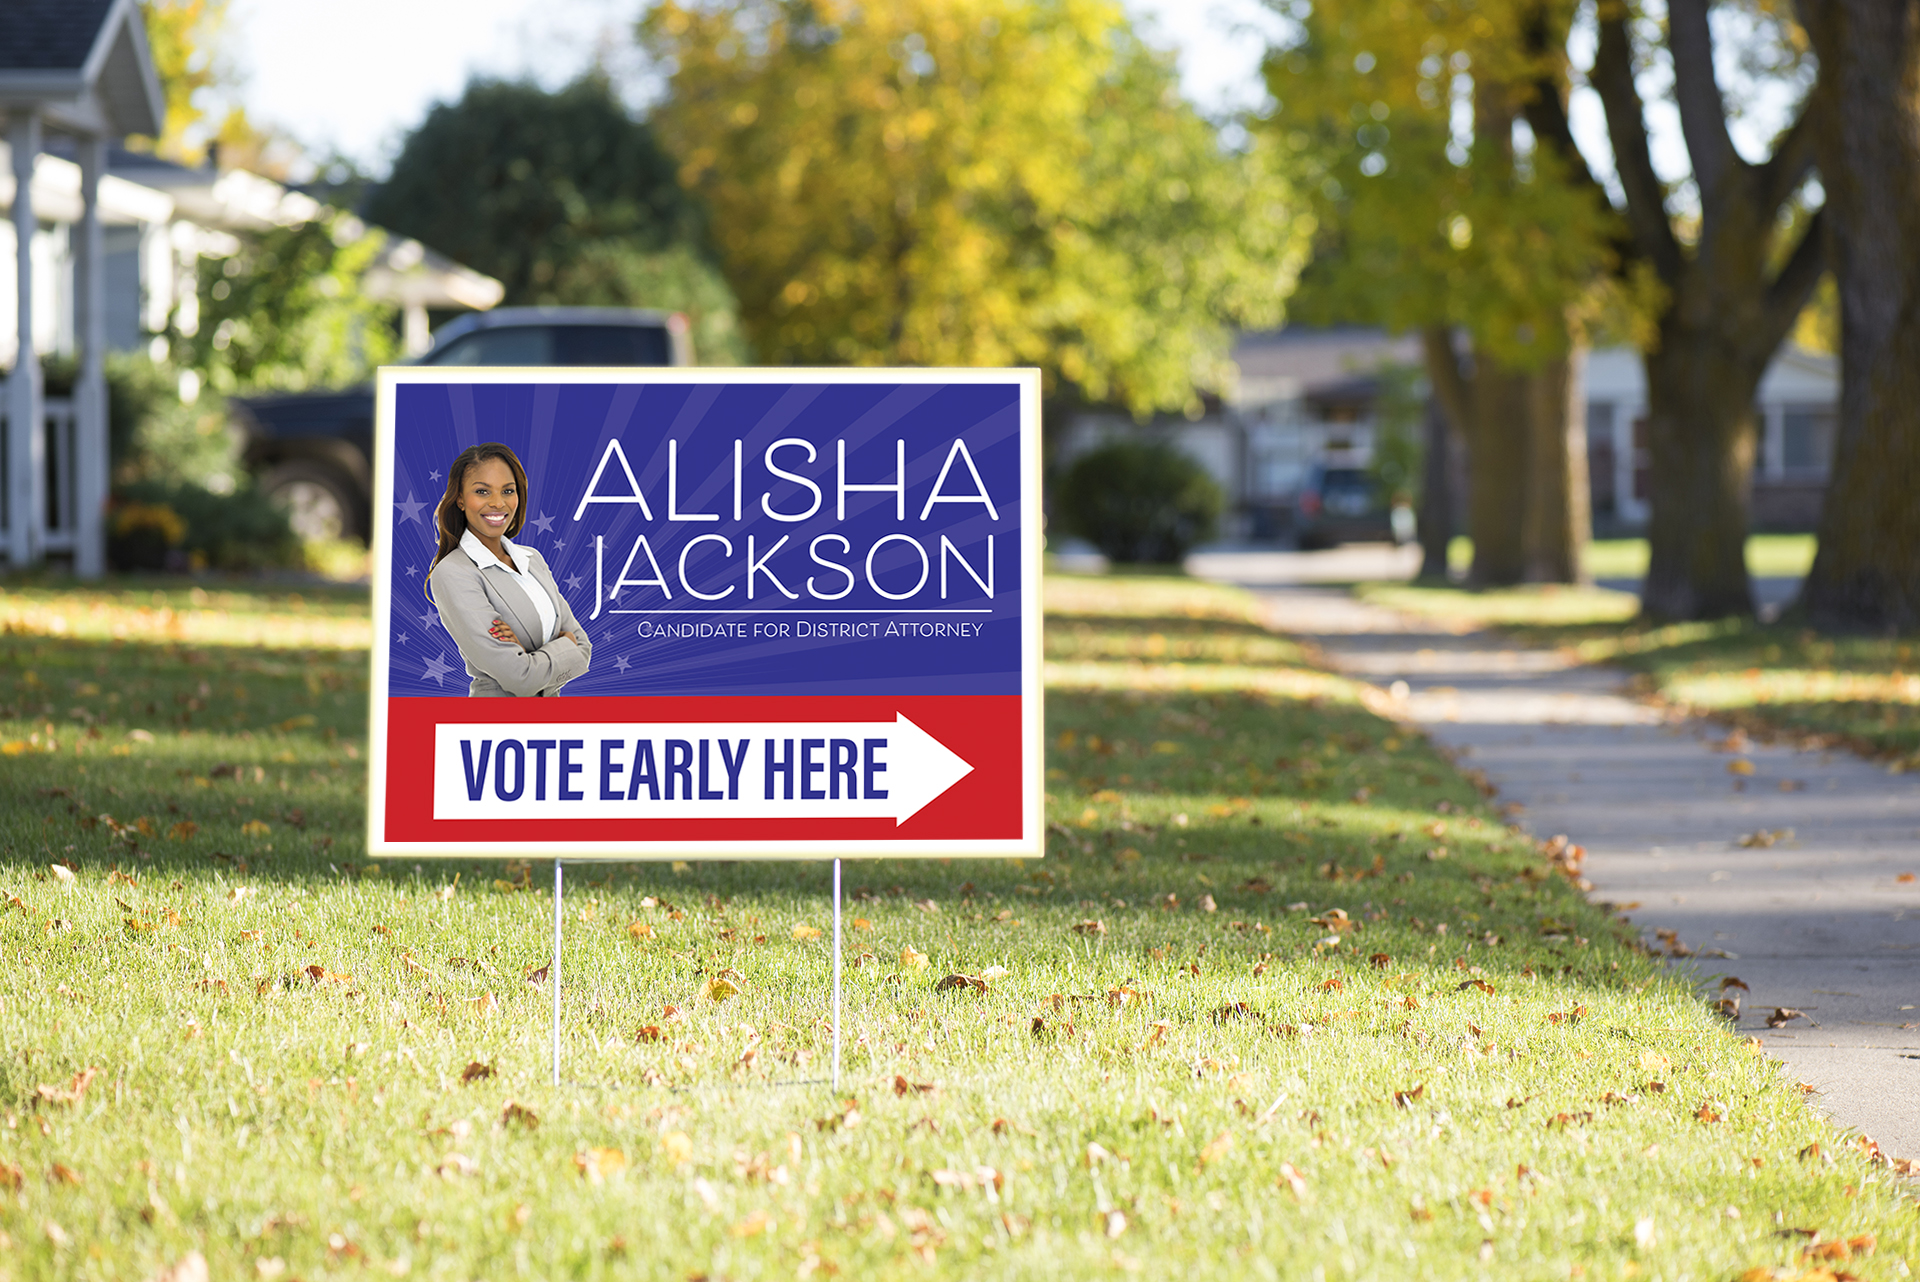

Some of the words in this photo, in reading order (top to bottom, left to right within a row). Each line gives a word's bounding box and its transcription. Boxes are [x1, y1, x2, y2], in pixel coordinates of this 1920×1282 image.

[574, 437, 1000, 522] ALISHA
[588, 533, 995, 621] JACKSON
[637, 620, 747, 638] CANDIDATE
[753, 622, 790, 638] FOR
[796, 620, 880, 638] DISTRICT
[884, 620, 983, 638] ATTORNEY
[459, 738, 585, 802] VOTE
[599, 738, 751, 801] EARLY
[764, 738, 889, 800] HERE
